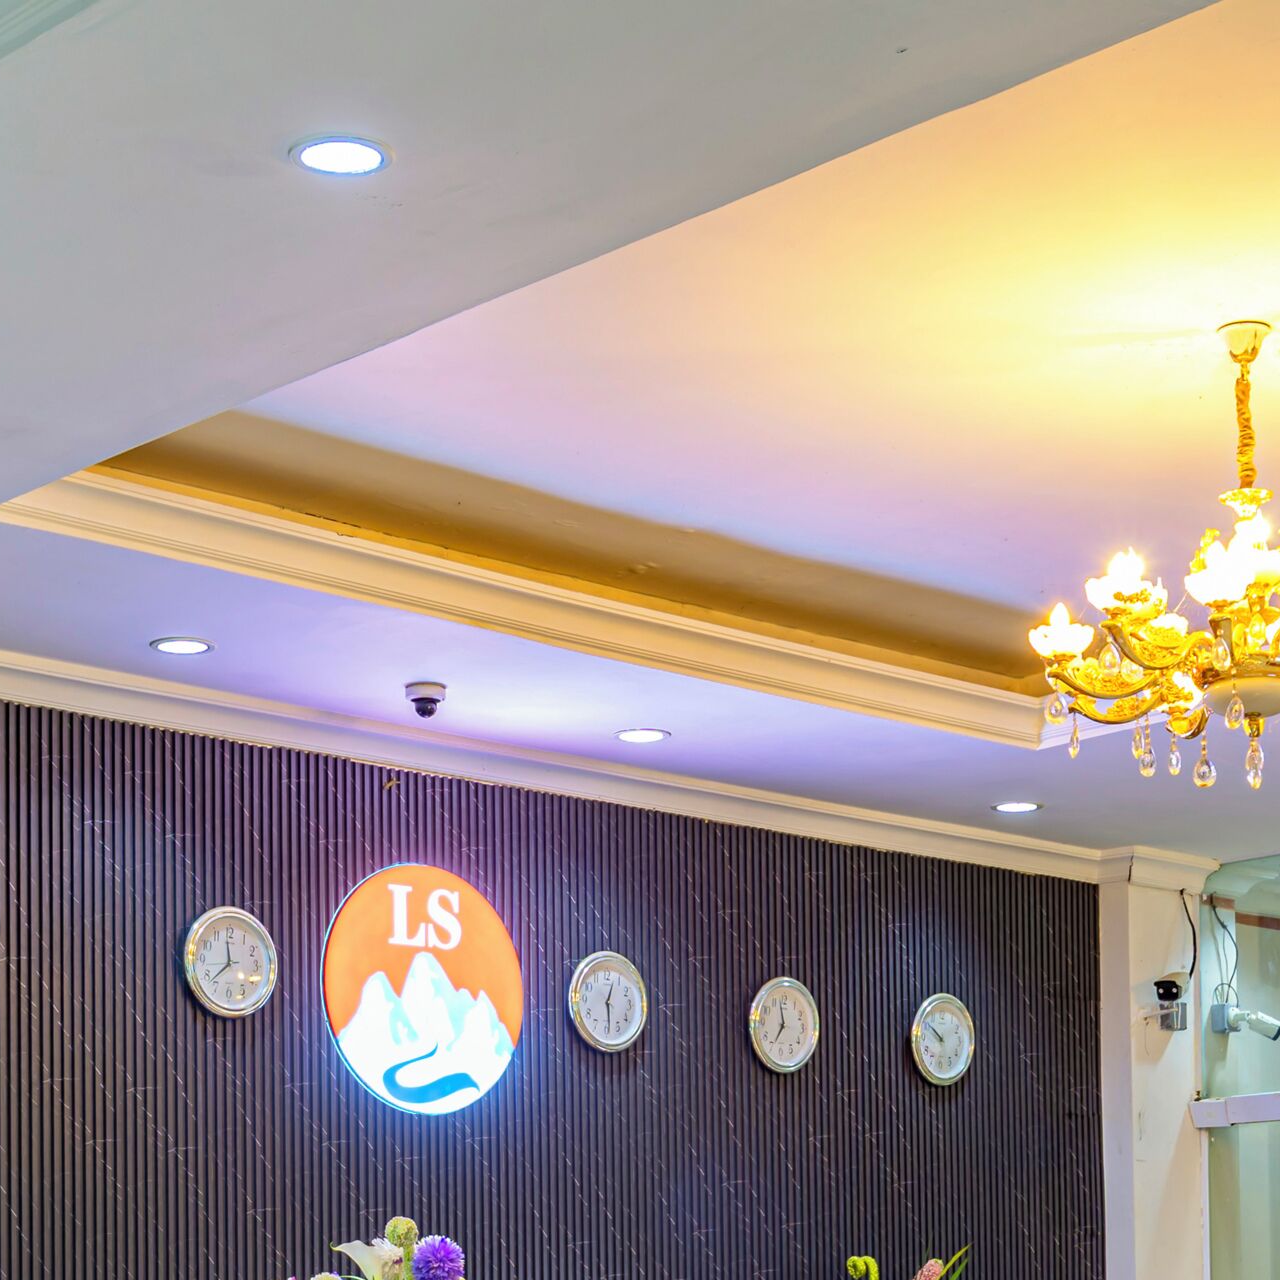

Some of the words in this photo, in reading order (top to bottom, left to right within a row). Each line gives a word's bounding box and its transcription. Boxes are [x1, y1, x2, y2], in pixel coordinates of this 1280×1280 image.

[386, 883, 463, 950] LS
[213, 930, 220, 942] 11
[226, 927, 234, 939] 12
[202, 940, 212, 952] 10
[249, 945, 256, 957] 2
[200, 954, 206, 966] 9
[253, 960, 259, 972] 3
[204, 968, 210, 980] 8
[212, 980, 219, 994] 7
[225, 986, 232, 999] 6
[240, 984, 246, 996] 5
